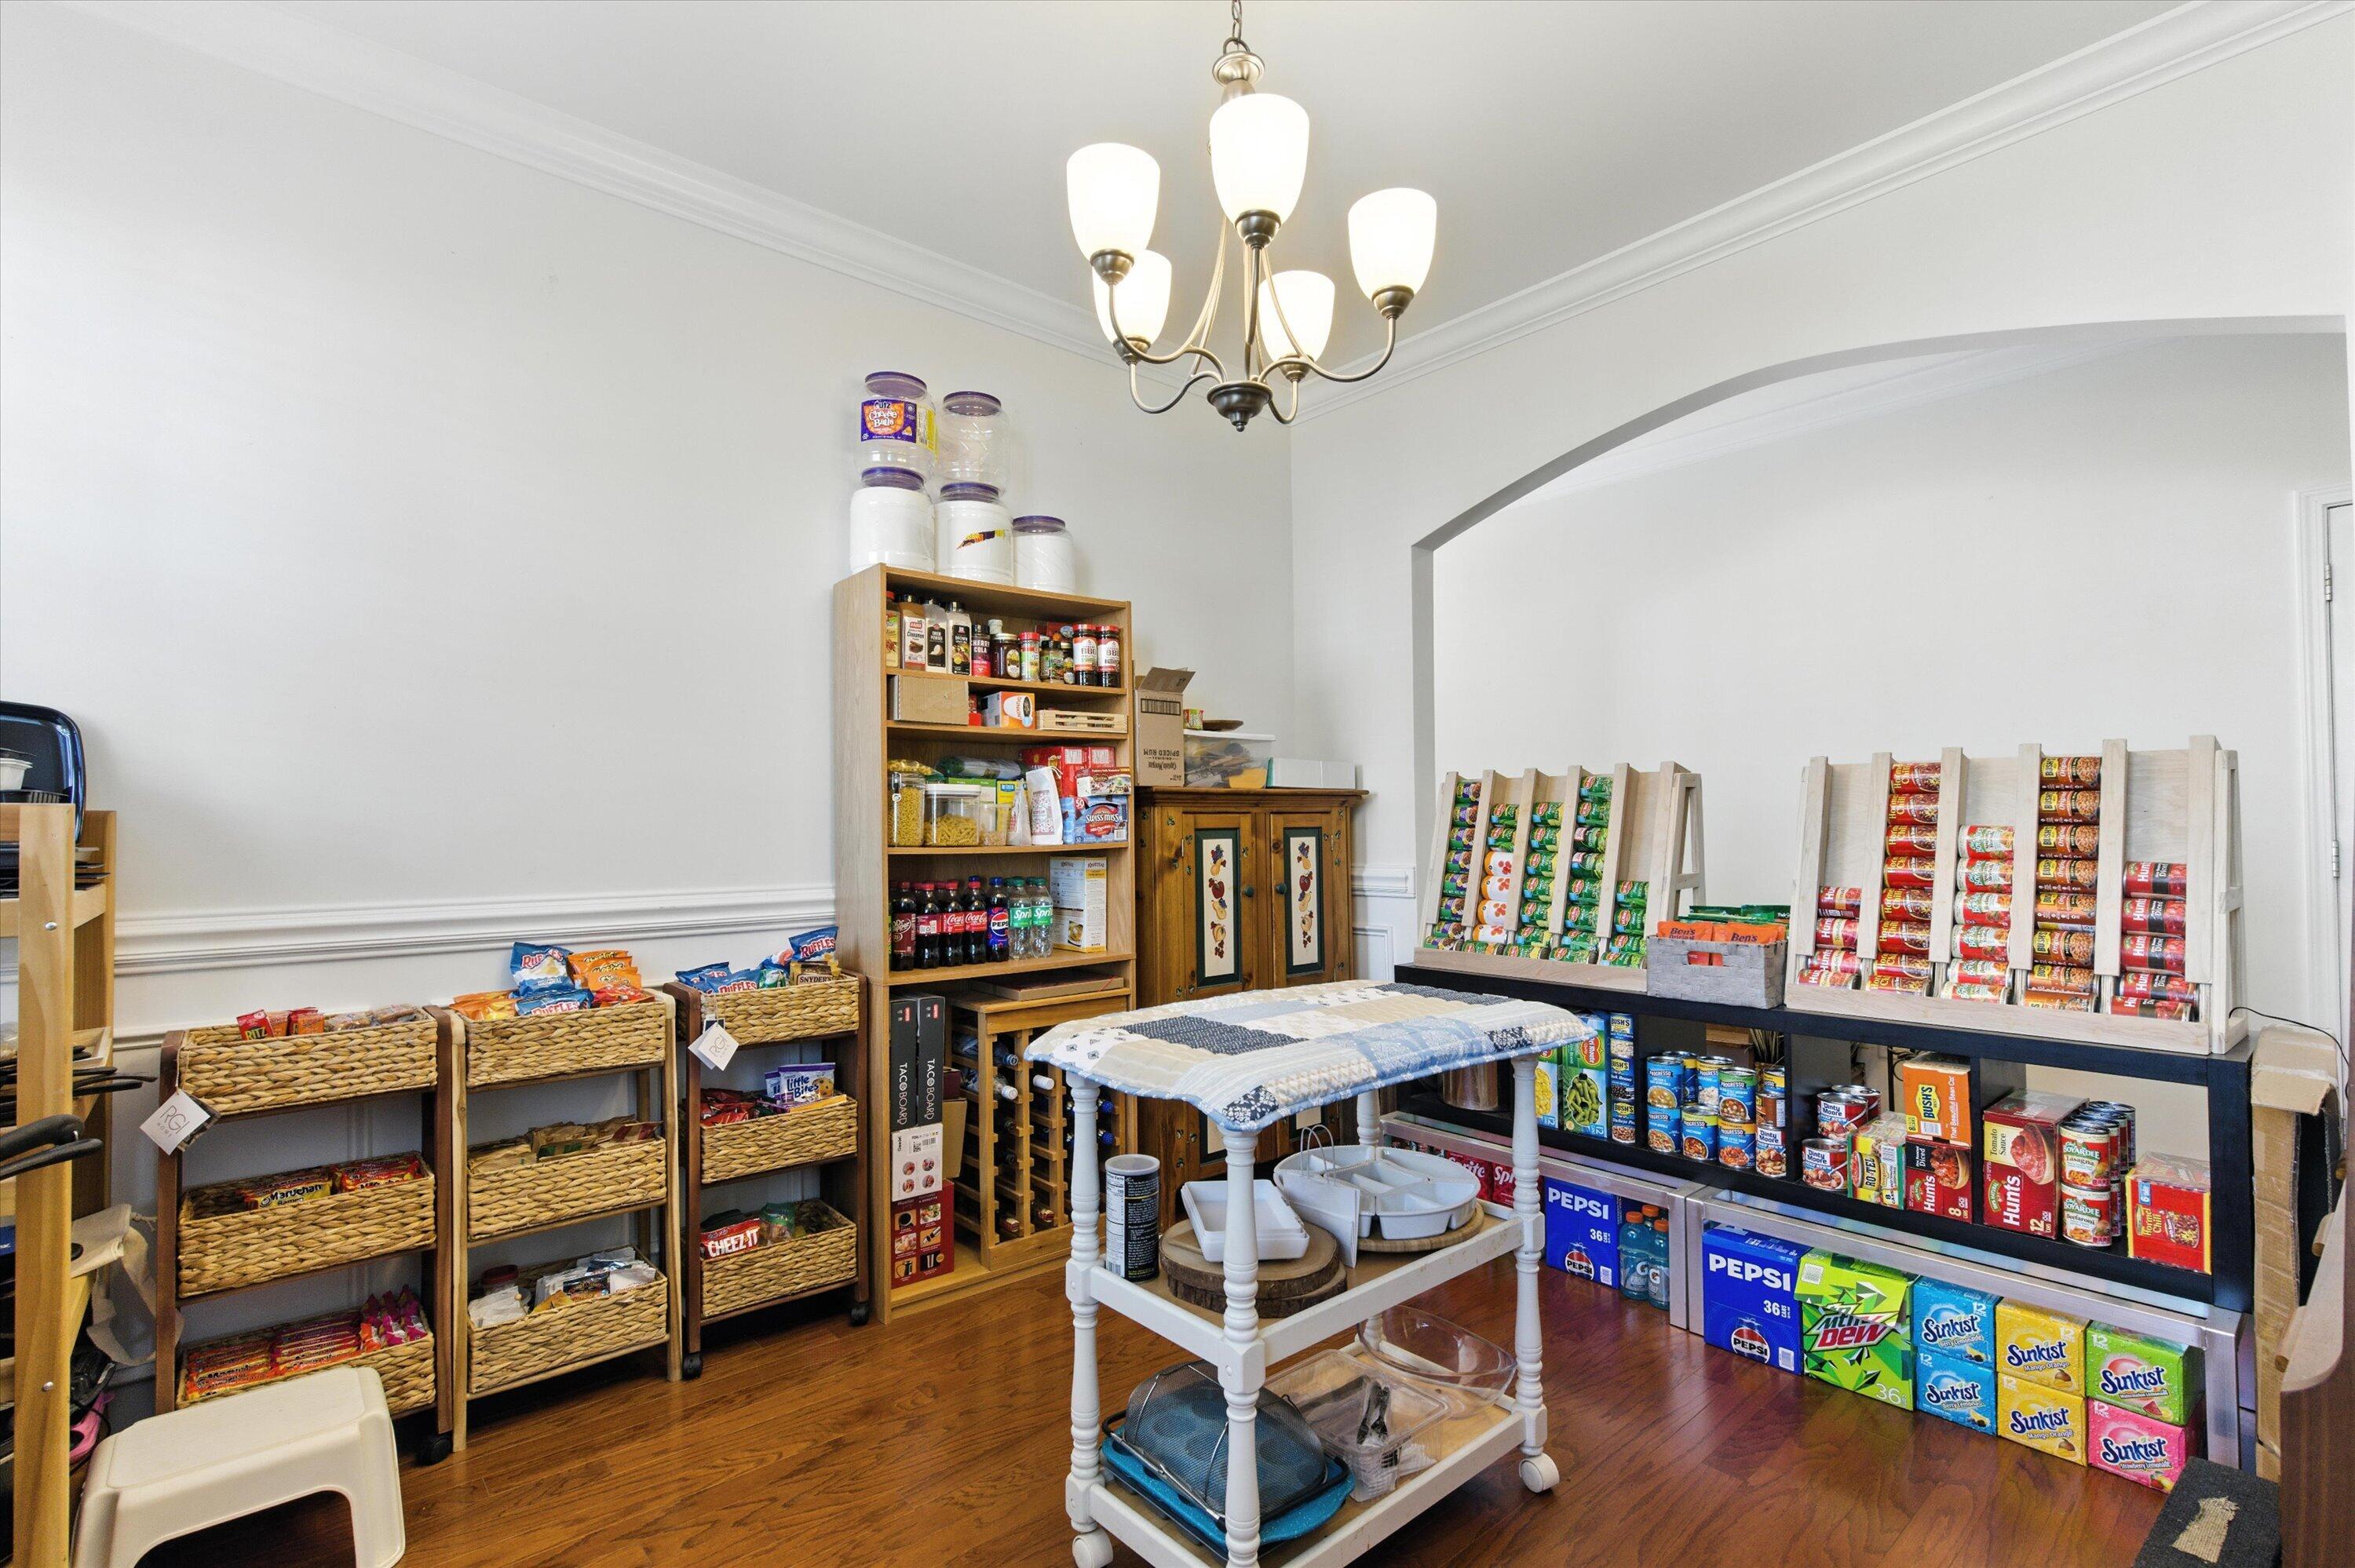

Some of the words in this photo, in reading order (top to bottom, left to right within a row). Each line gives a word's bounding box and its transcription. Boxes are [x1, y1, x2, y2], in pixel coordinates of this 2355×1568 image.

[869, 410, 897, 421] Cheese
[874, 418, 894, 428] Balls
[1076, 798, 1084, 808] 50
[1670, 926, 1696, 936] Ben's
[1731, 932, 1758, 942] Ben's
[800, 938, 835, 958] RUFFLES
[2038, 932, 2046, 952] BUSH'S
[799, 975, 832, 983] SNYDER'S
[245, 1029, 268, 1041] RITZ
[787, 1075, 810, 1092] Little
[794, 1083, 820, 1099] Bites
[899, 1092, 907, 1125] BOARD
[1615, 1104, 1634, 1113] BUSH'S
[1824, 1103, 1840, 1111] Dinty
[1922, 1086, 1935, 1119] BUSH'S
[1948, 1100, 1957, 1125] Beautiful
[1759, 1135, 1779, 1143] Moore
[1760, 1129, 1777, 1139] Dinty
[1807, 1155, 1827, 1164] Moore
[1808, 1149, 1825, 1159] Dinty
[2064, 1146, 2101, 1160] BOYARDEE
[2066, 1155, 2094, 1166] Lasagna
[269, 1183, 323, 1204] Maruchan
[1548, 1187, 1609, 1220] PEPSI
[2064, 1202, 2101, 1216] BOYARDEE
[1948, 1207, 1962, 1217] 8
[2066, 1212, 2095, 1225] Beefaroni
[2030, 1219, 2045, 1232] 12
[2152, 1212, 2162, 1234] Chili
[1590, 1228, 1603, 1242] 36
[1566, 1259, 1593, 1274] PEPSI
[1709, 1253, 1791, 1293] PEPSI
[1763, 1300, 1780, 1317] 36
[1972, 1302, 1987, 1315] 12
[1923, 1315, 1981, 1344] Sunkist
[2060, 1327, 2075, 1338] 12
[1733, 1336, 1768, 1357] PEPSI
[1939, 1340, 1954, 1348] Berry
[1954, 1334, 1984, 1347] Lemonade
[2092, 1334, 2108, 1346] 12
[1920, 1352, 1932, 1363] 12
[2007, 1340, 2067, 1366] Sunkist
[2025, 1363, 2046, 1372] Mango
[2046, 1361, 2070, 1370] Orange
[2003, 1377, 2017, 1389] 12
[2101, 1366, 2167, 1395] Sunkist
[1875, 1382, 1902, 1406] 36
[1926, 1380, 1981, 1404] Sunkist
[2093, 1401, 2109, 1413] 12
[2010, 1406, 2069, 1434] Sunkist
[2028, 1430, 2049, 1440] Mango
[2050, 1428, 2074, 1439] Orange
[2101, 1438, 2167, 1464] Sunkist
[2120, 1461, 2145, 1471] Strawberry
[2145, 1459, 2172, 1469] Lemonade
